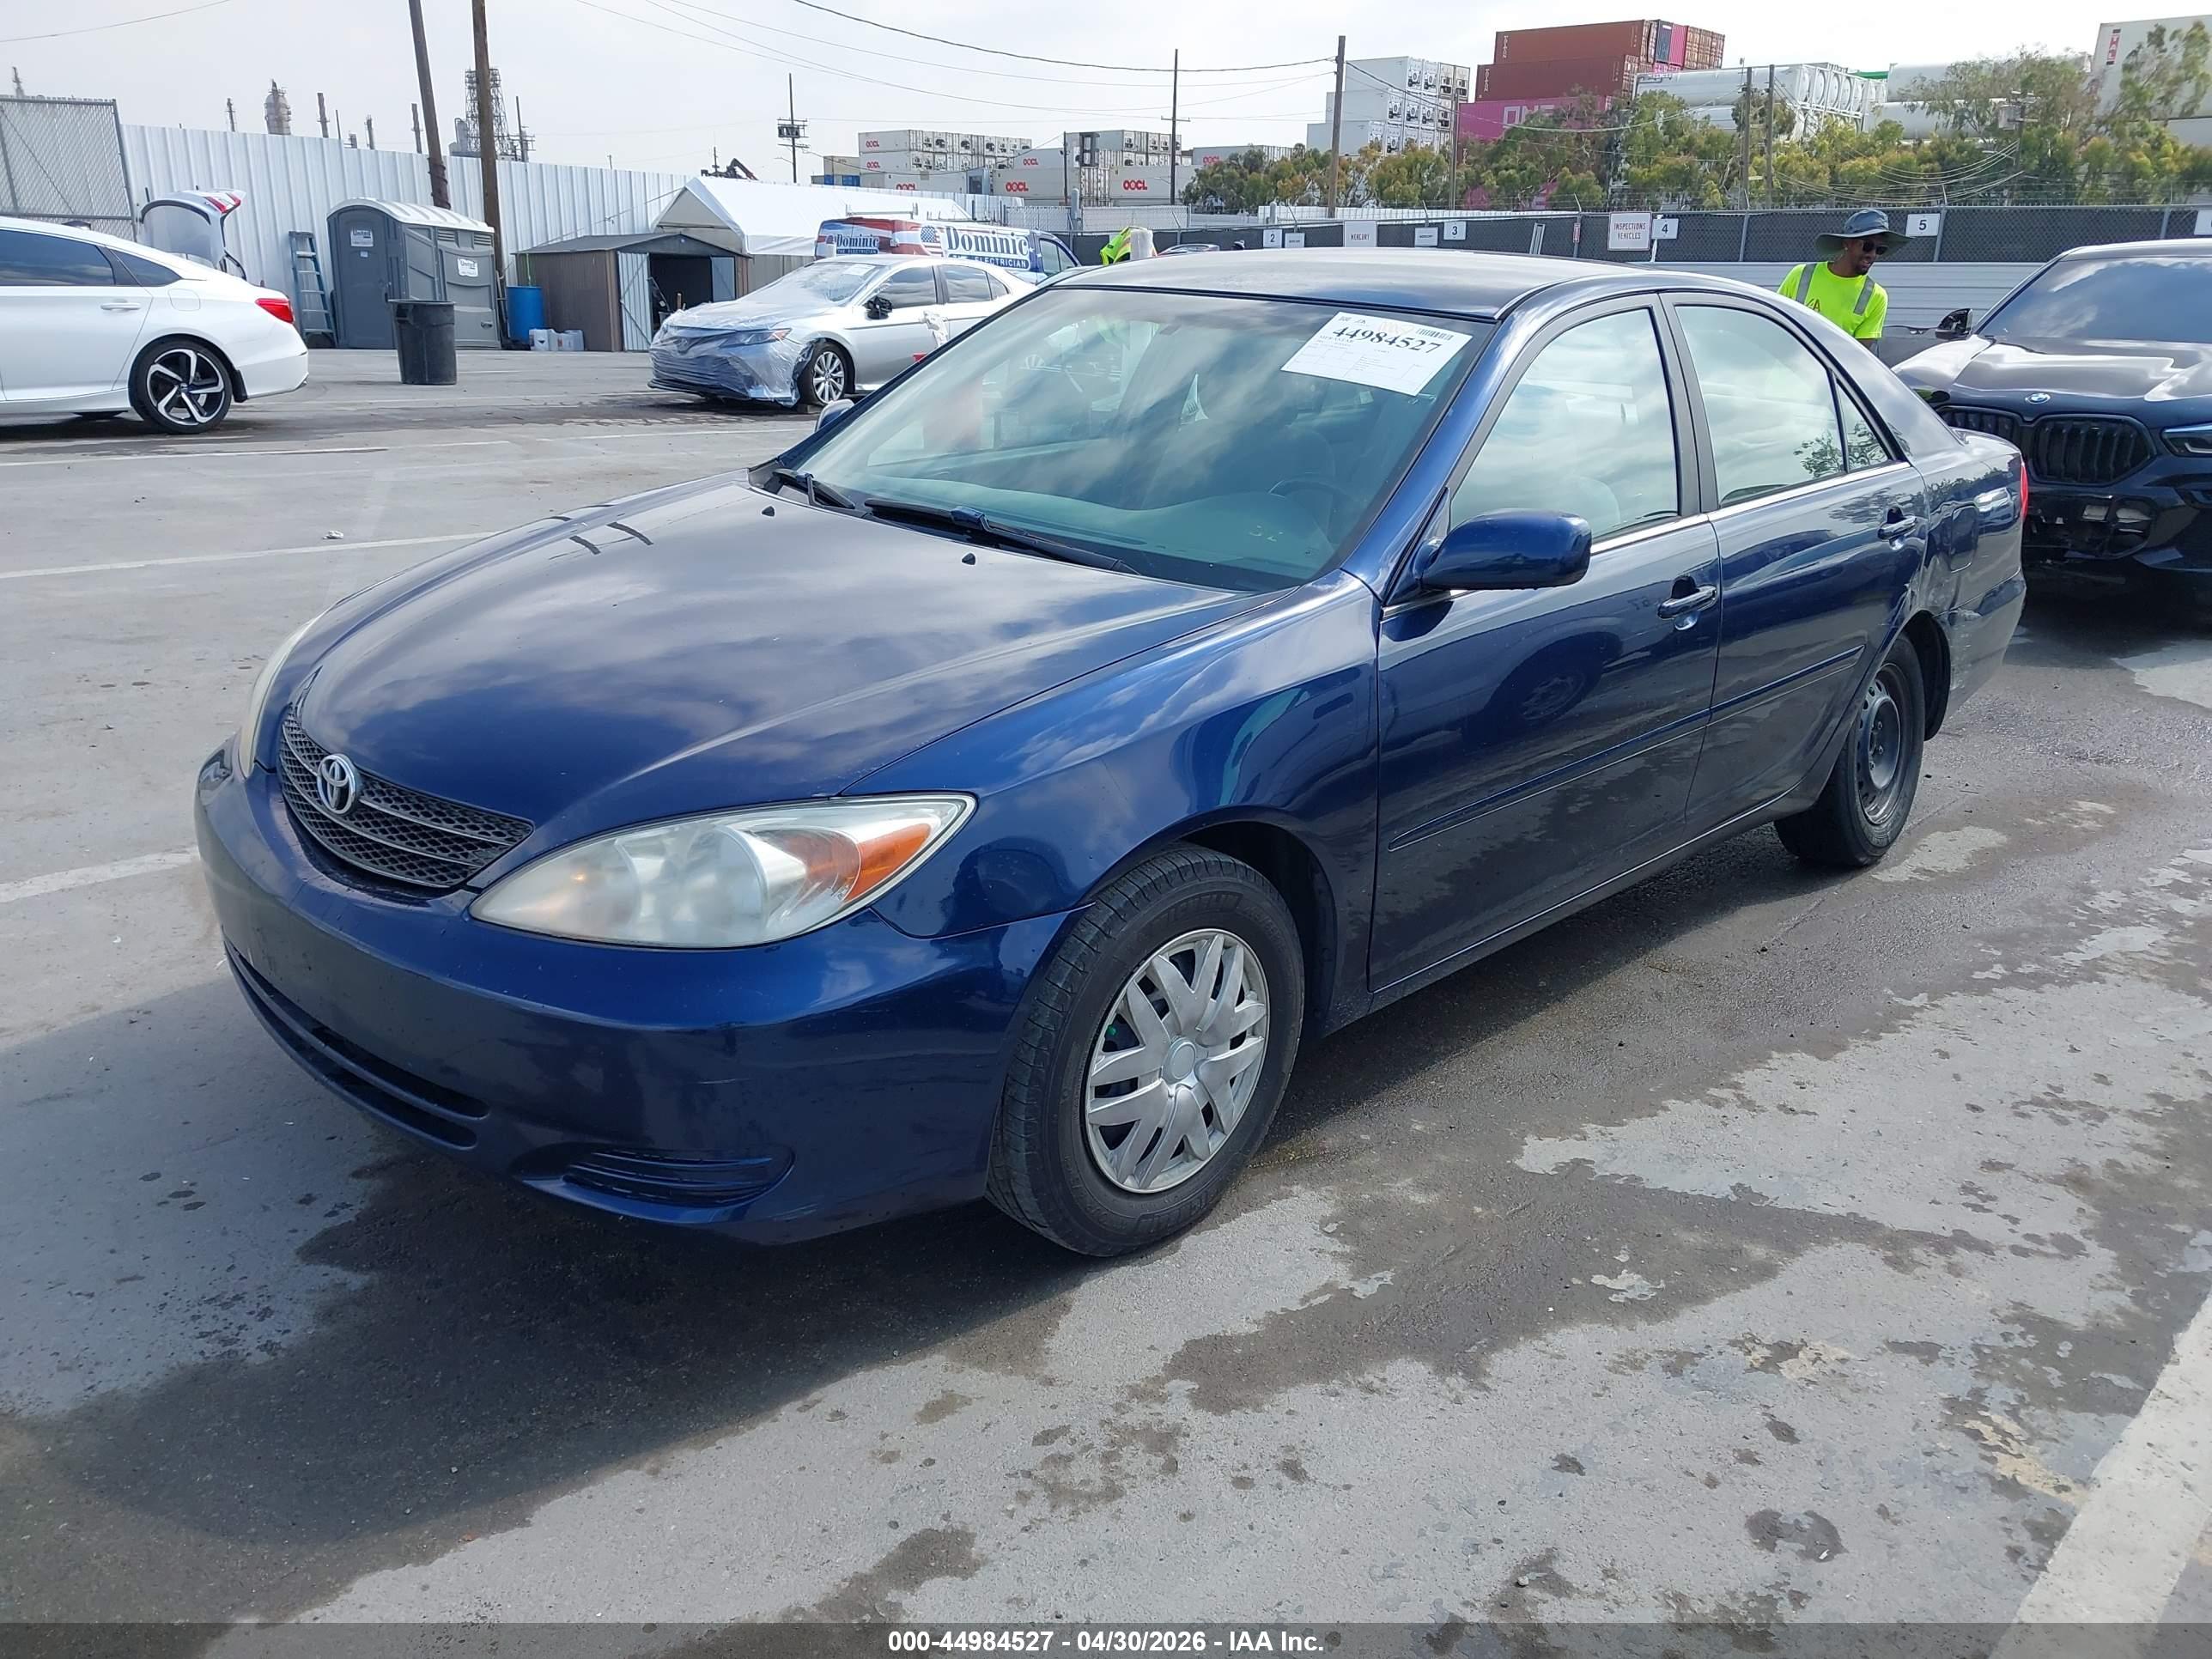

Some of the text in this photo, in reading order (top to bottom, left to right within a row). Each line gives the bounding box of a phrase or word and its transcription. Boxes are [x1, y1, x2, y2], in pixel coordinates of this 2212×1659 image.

[1006, 181, 1029, 191] OOCL
[1123, 179, 1148, 191] OOCL
[1451, 226, 1458, 235] 3
[1662, 223, 1668, 234] 4
[1918, 219, 1927, 231] 5
[836, 234, 879, 250] Dominic
[945, 226, 1028, 256] Dominic
[1270, 234, 1275, 243] 2
[975, 256, 1027, 268] ELECTRICIAN
[1333, 326, 1443, 354] 44984527
